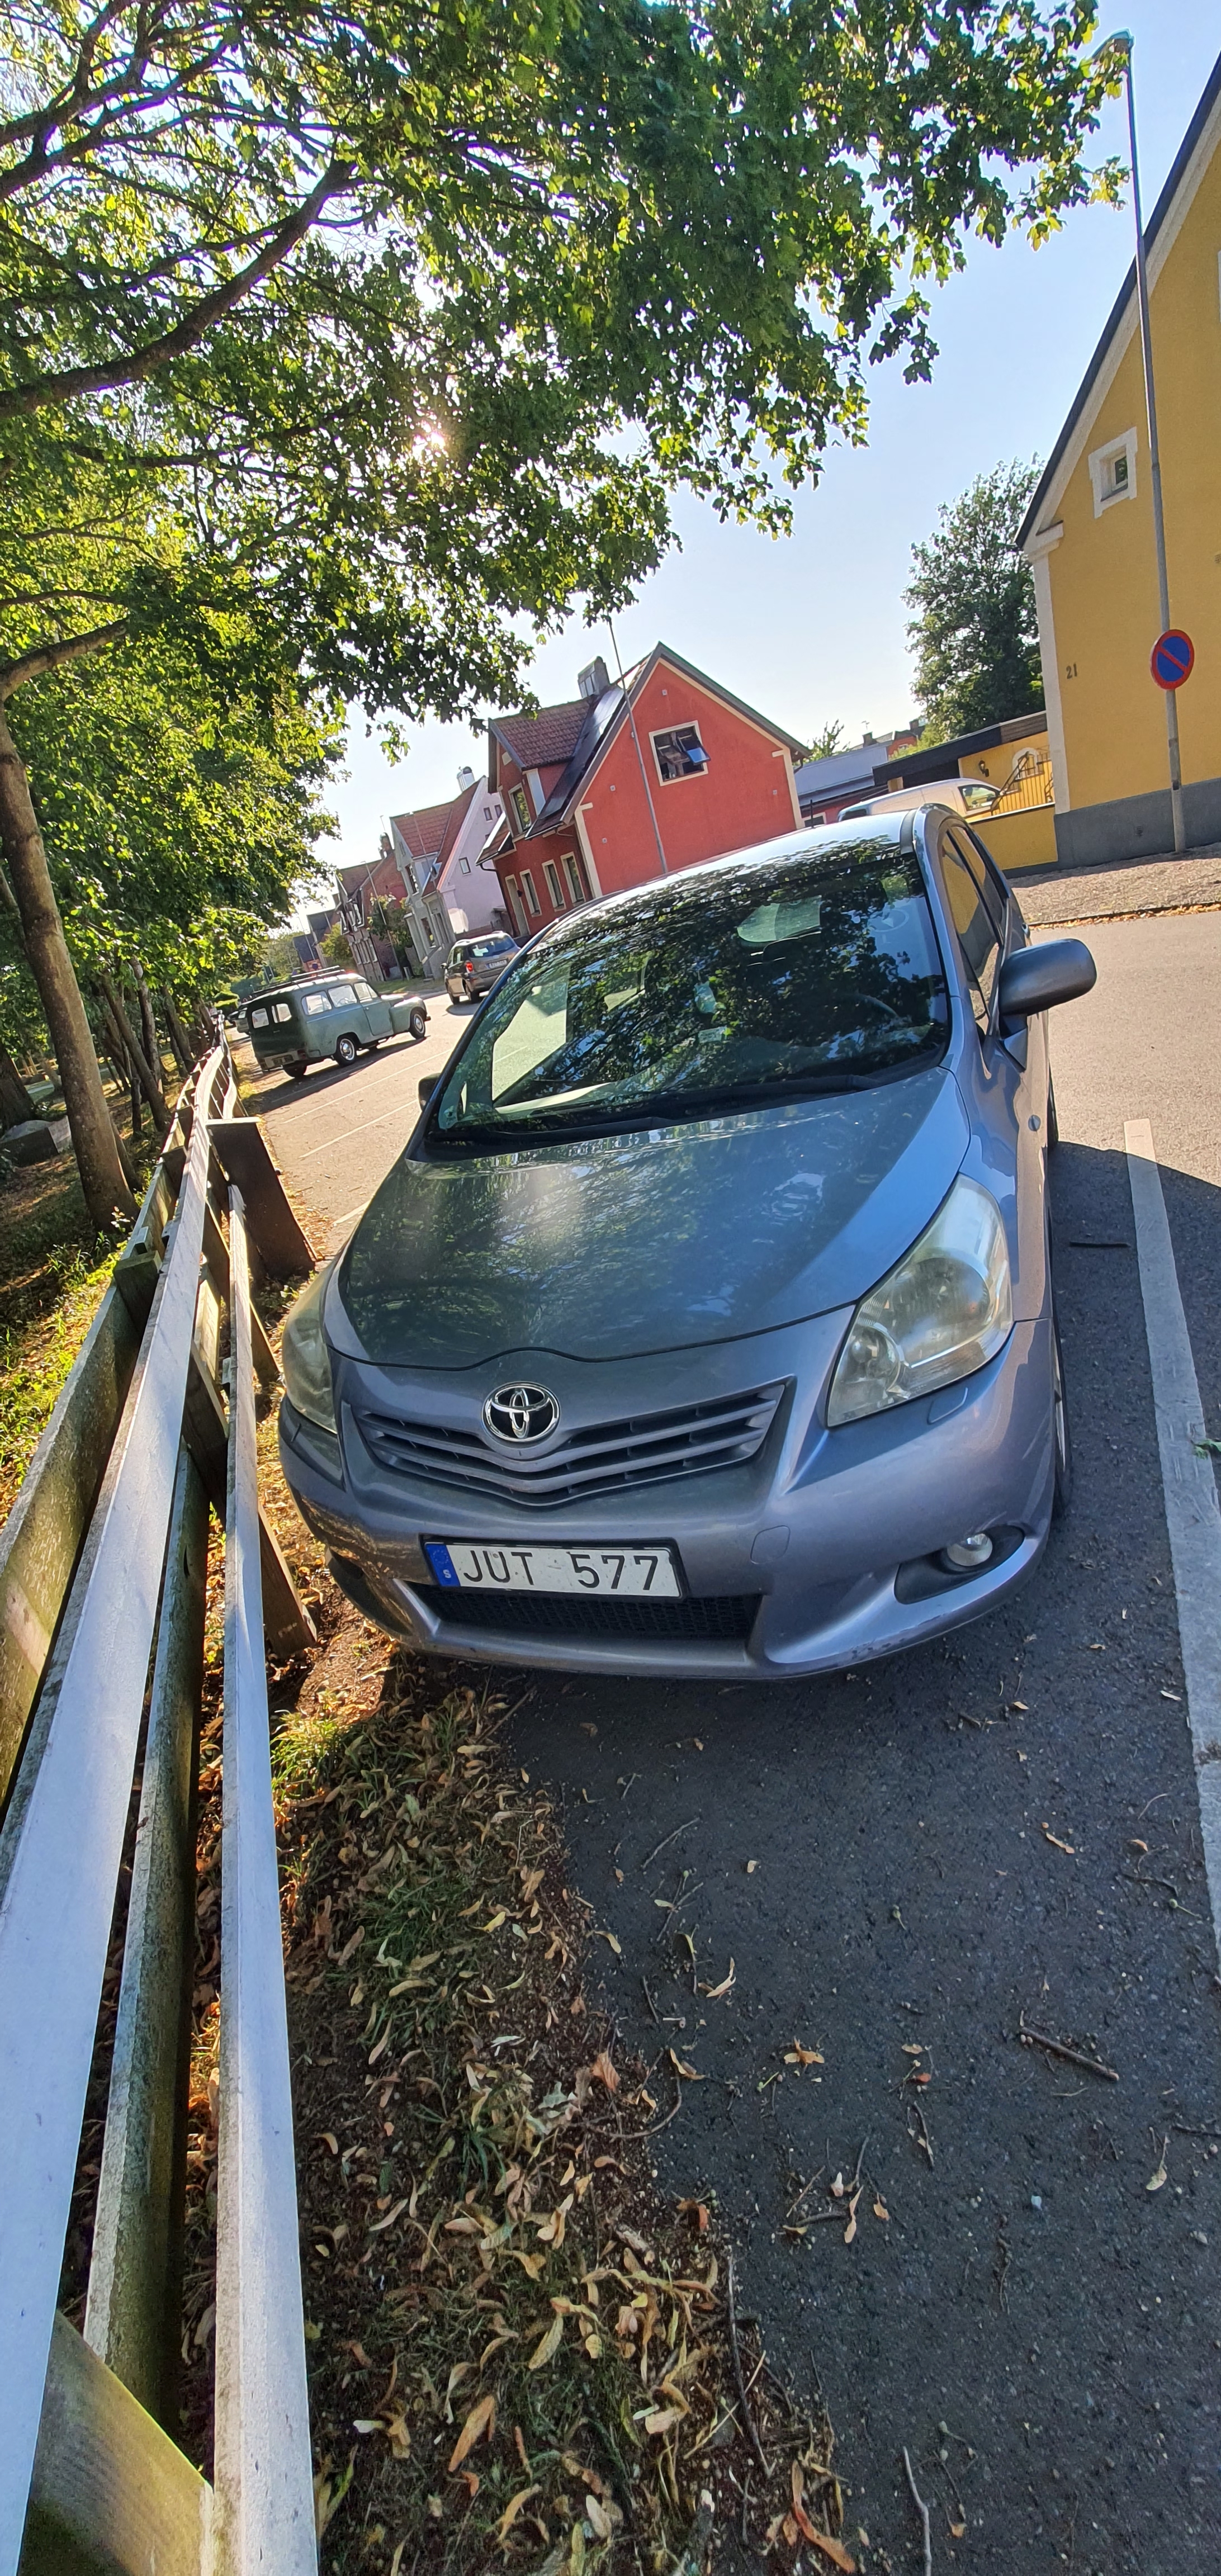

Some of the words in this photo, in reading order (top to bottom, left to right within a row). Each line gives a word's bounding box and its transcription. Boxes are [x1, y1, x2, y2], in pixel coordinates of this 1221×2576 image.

[1066, 663, 1078, 680] 21
[443, 1569, 452, 1579] S
[463, 1550, 534, 1586] JUT
[566, 1552, 659, 1590] 577
